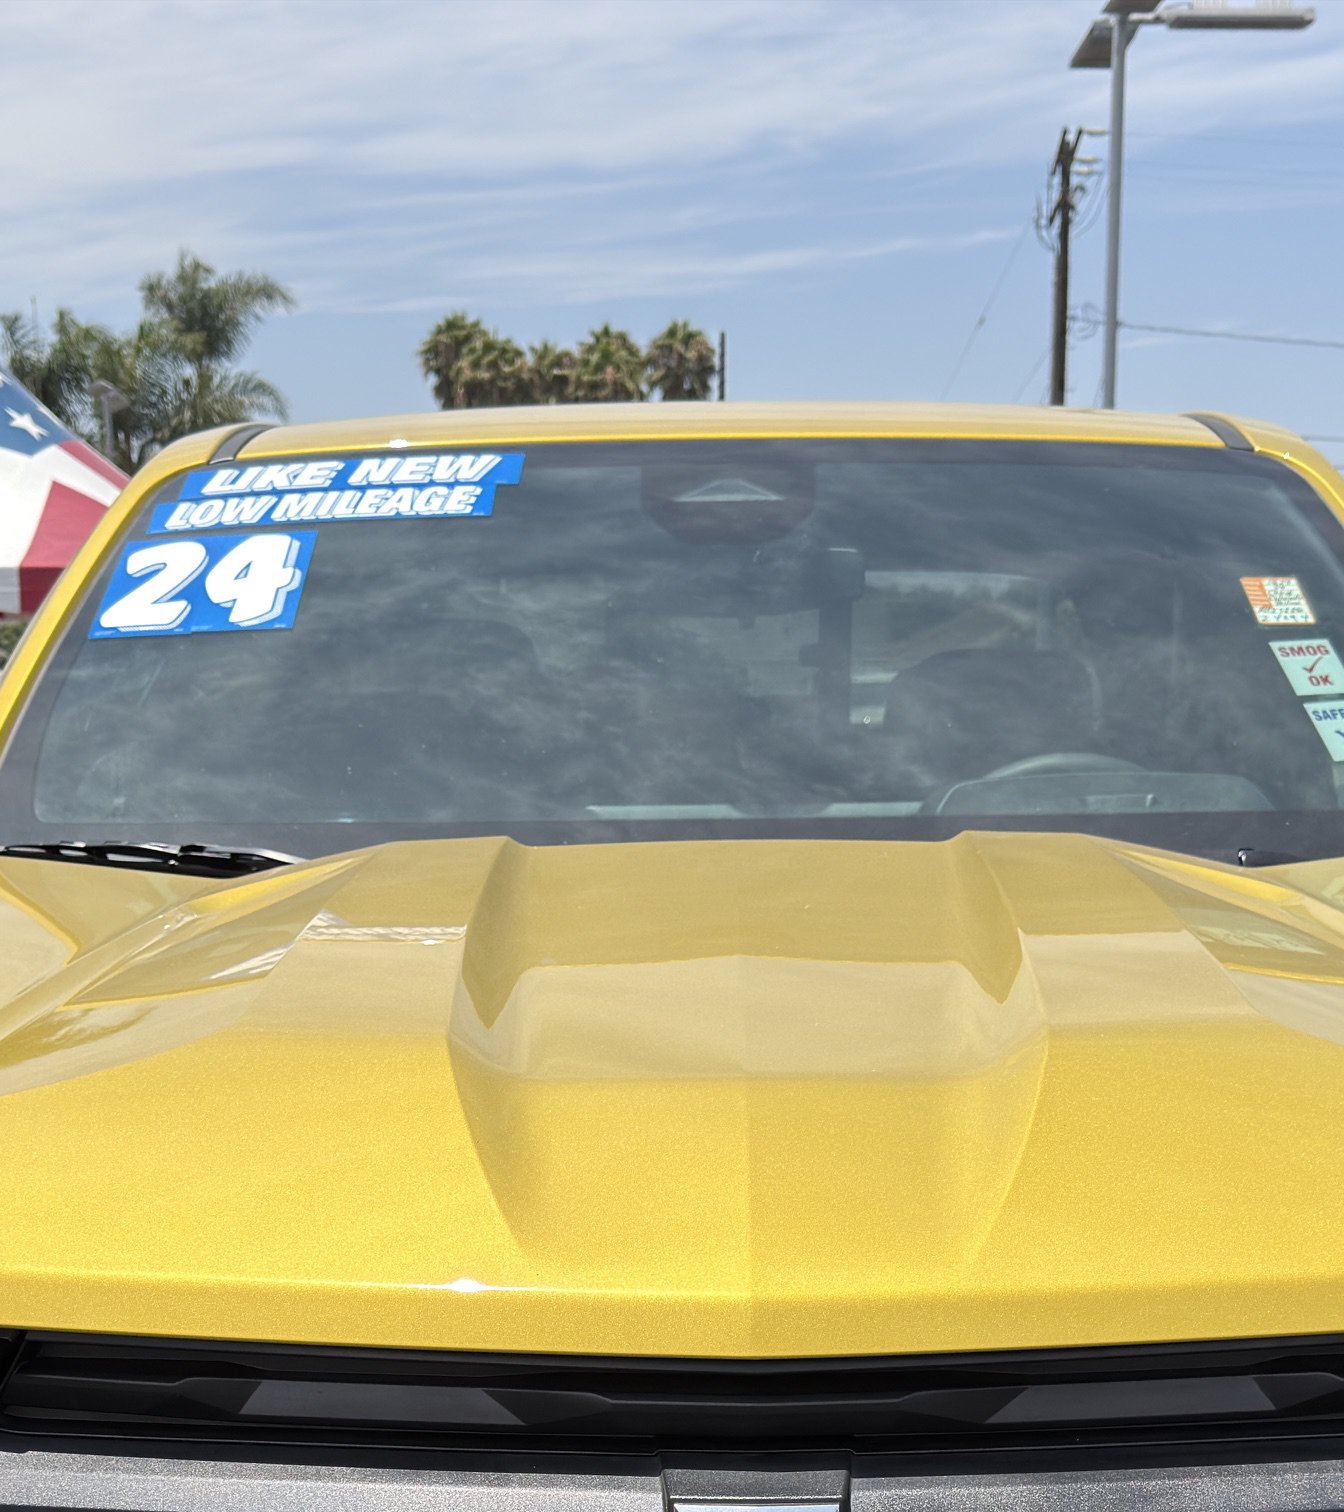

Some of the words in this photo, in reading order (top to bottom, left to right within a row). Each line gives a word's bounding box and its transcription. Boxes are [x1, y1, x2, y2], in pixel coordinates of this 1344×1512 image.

[201, 460, 345, 496] LIKE
[347, 454, 502, 485] NEW
[165, 496, 278, 530] LOW
[271, 485, 483, 521] MILEAGE
[100, 534, 302, 632] 24
[1278, 645, 1329, 658] SMOG
[1308, 674, 1334, 687] OK
